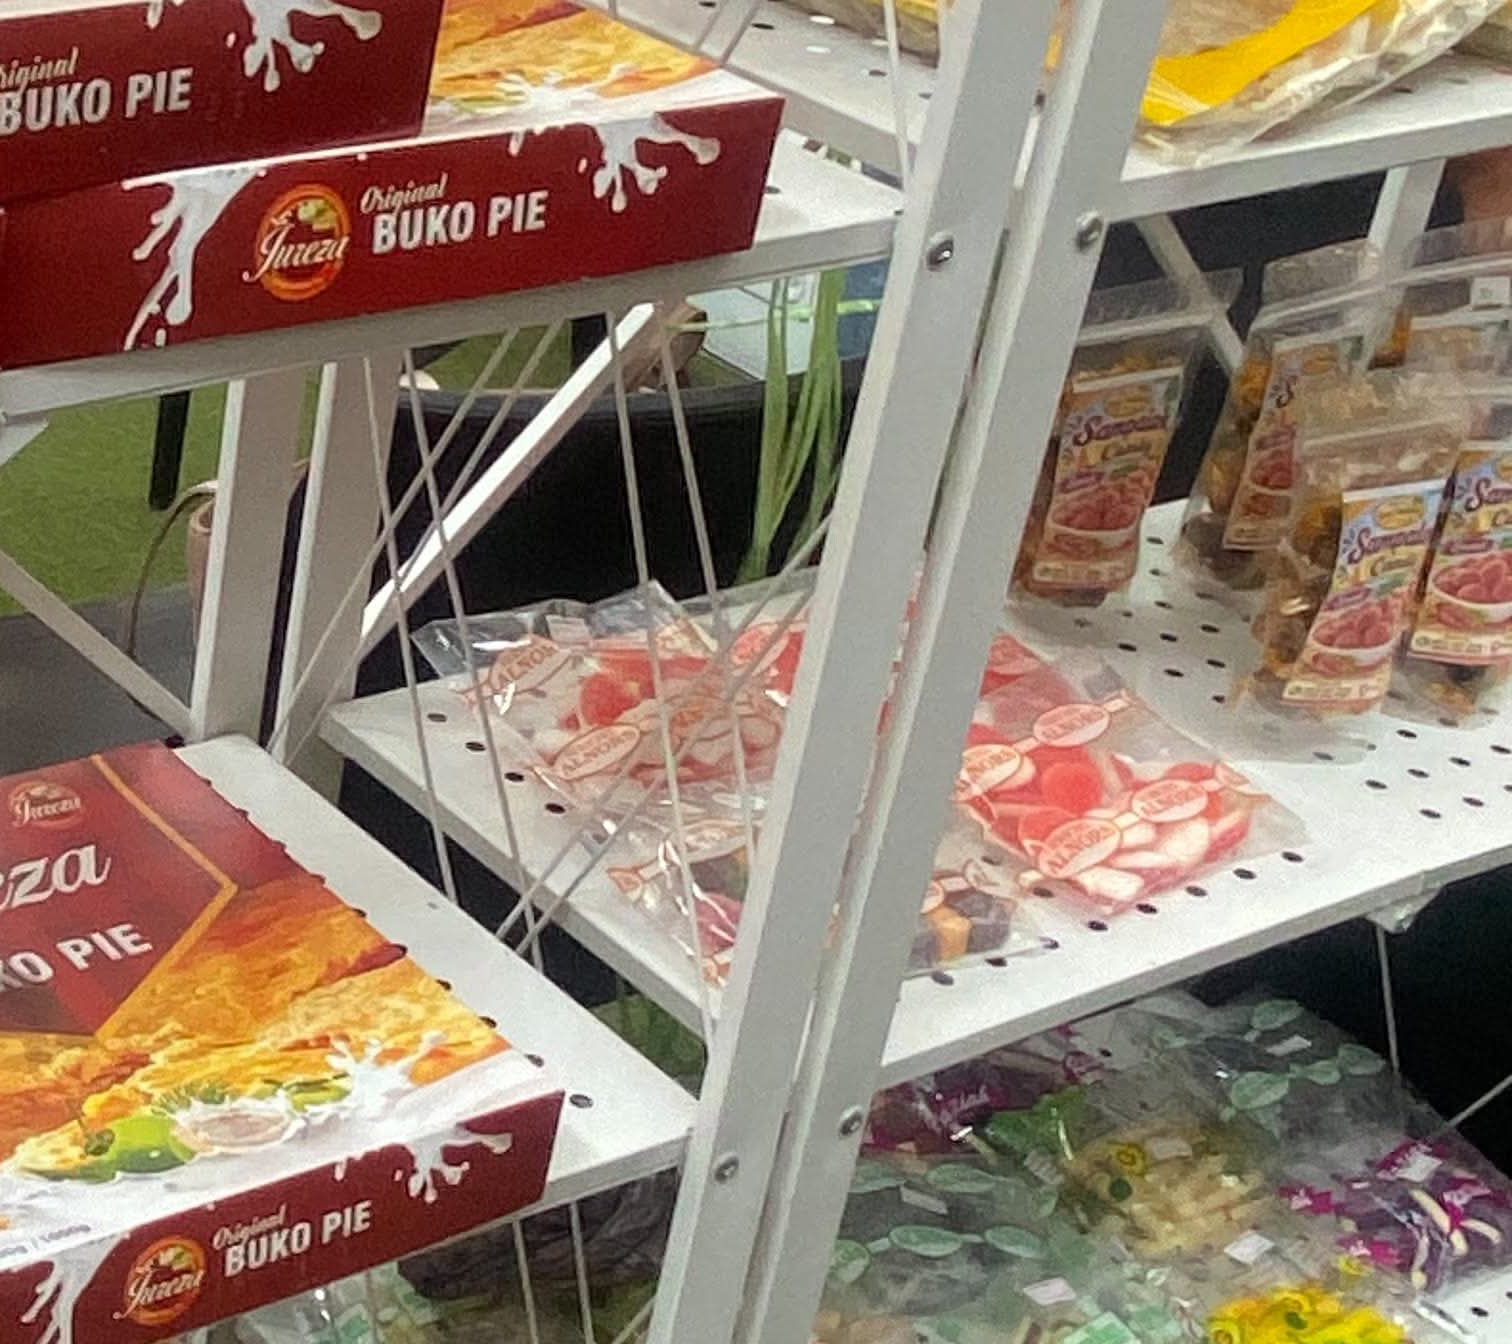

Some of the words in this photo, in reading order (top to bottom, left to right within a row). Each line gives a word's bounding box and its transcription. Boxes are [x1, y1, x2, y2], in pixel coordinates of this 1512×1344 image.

[124, 67, 194, 120] PIE
[360, 172, 449, 216] Original
[372, 203, 475, 255] BUKO
[487, 189, 549, 236] PIE
[243, 222, 349, 283] Jureza
[55, 922, 154, 971] PIE
[211, 1204, 287, 1250] Original
[223, 1223, 312, 1278] BUKO
[321, 1200, 372, 1245] PIE
